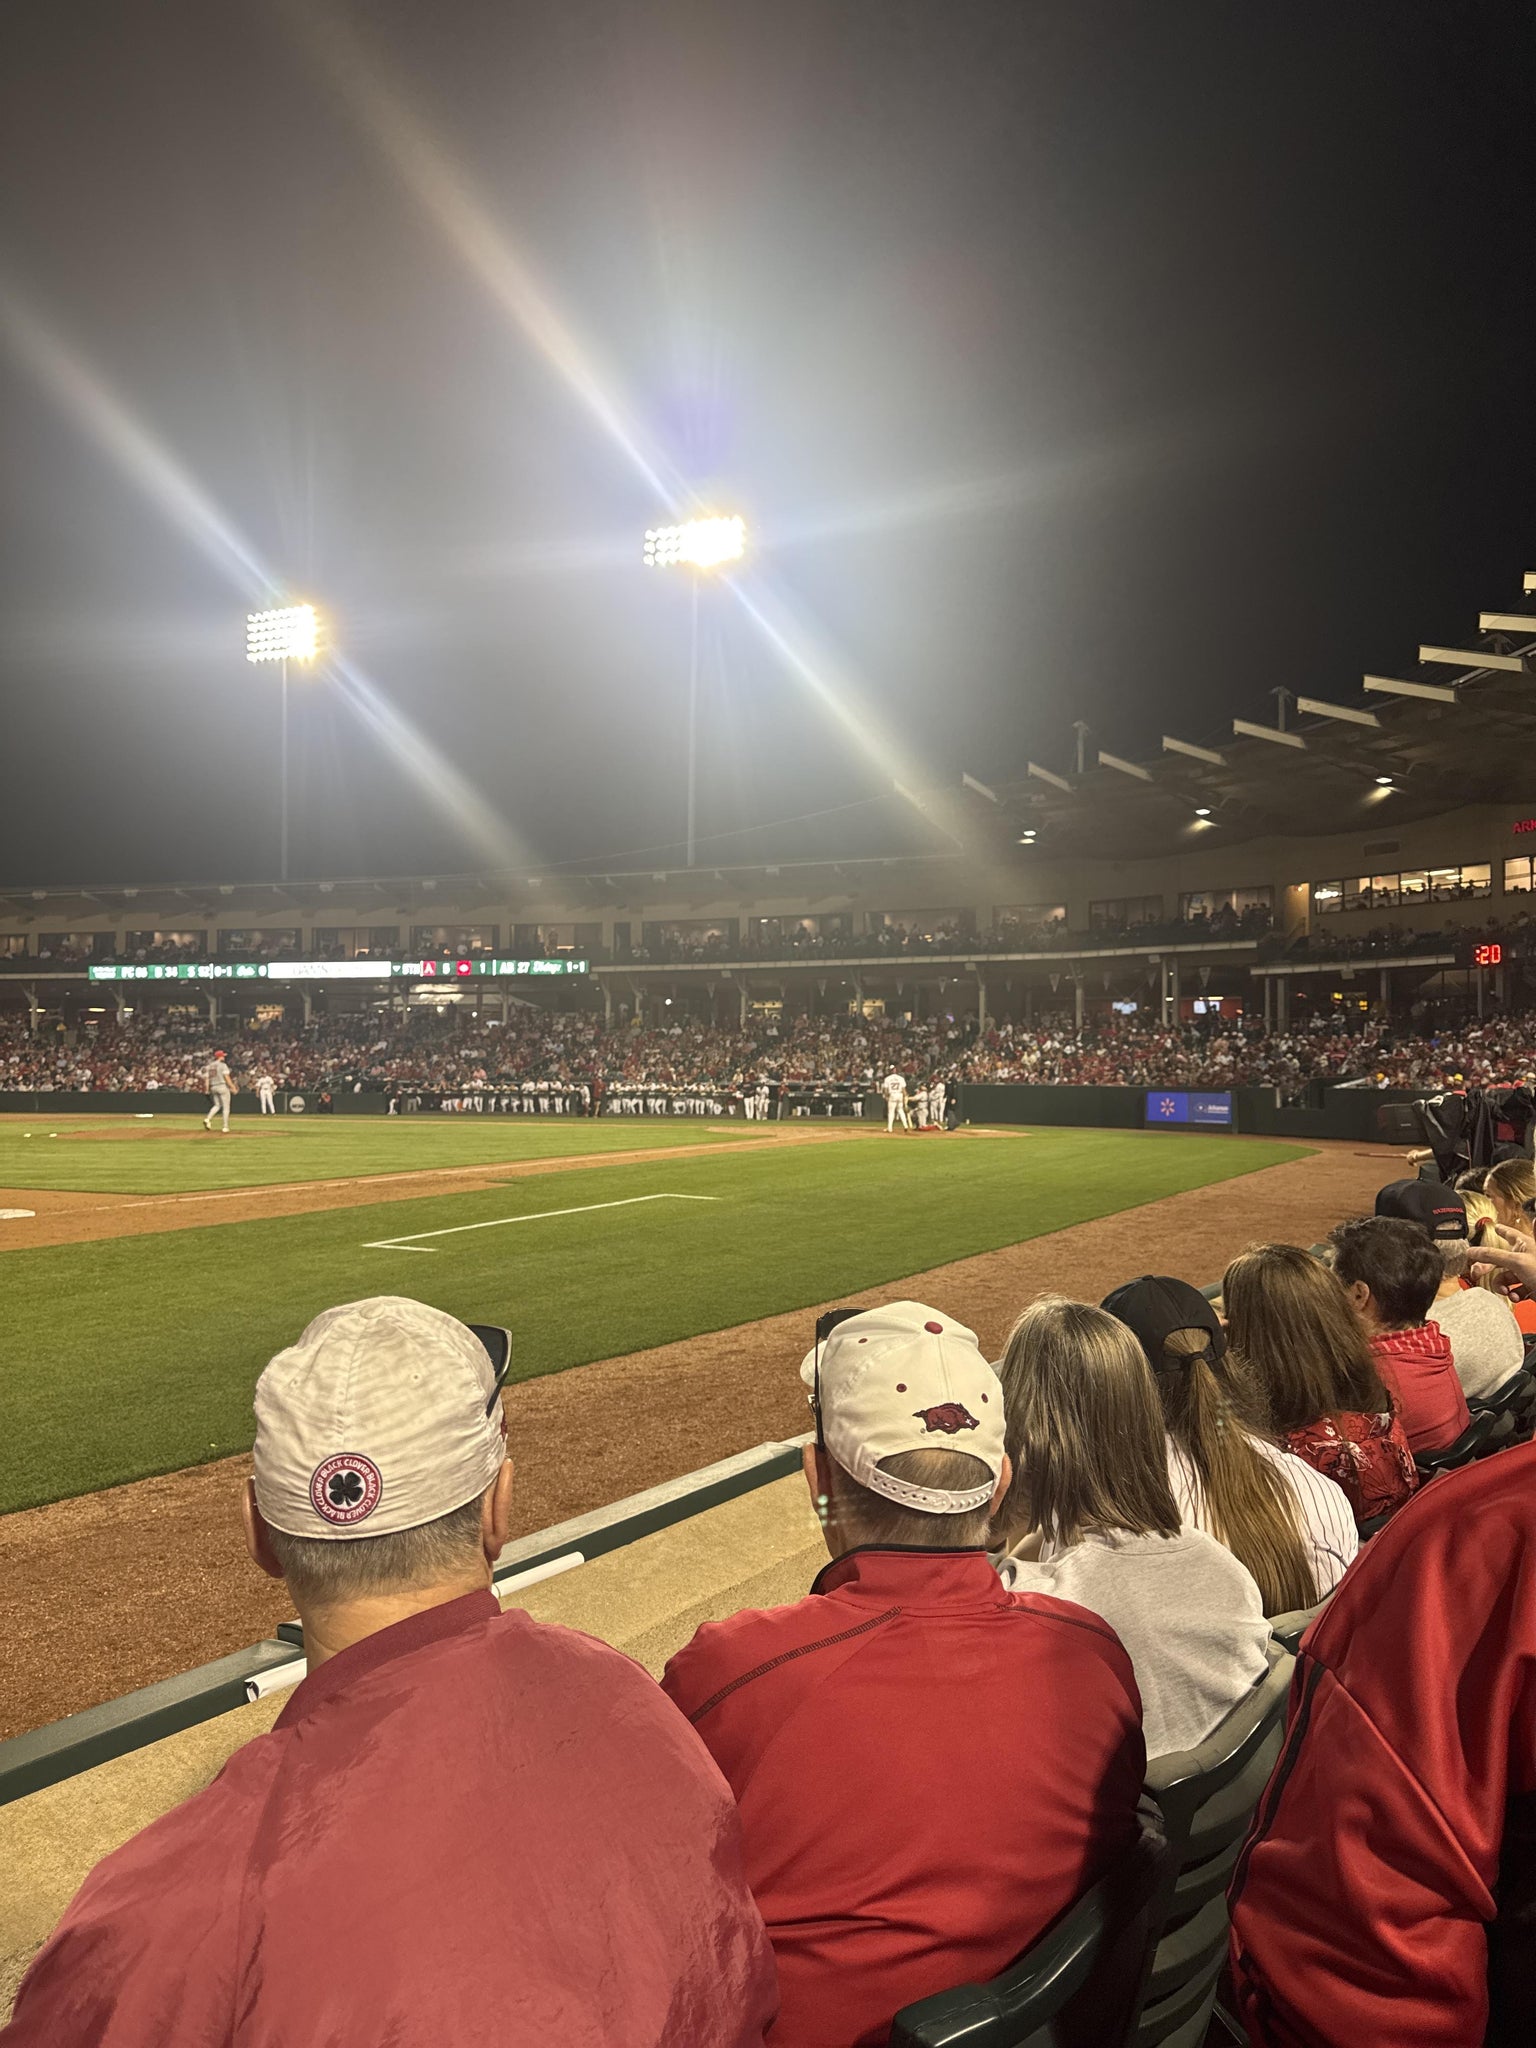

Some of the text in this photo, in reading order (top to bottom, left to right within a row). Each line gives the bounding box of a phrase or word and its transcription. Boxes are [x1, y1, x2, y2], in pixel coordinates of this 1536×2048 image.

[314, 1458, 377, 1520] BLACK CLOVER BLACK CLOVER BLACK CLOVER
